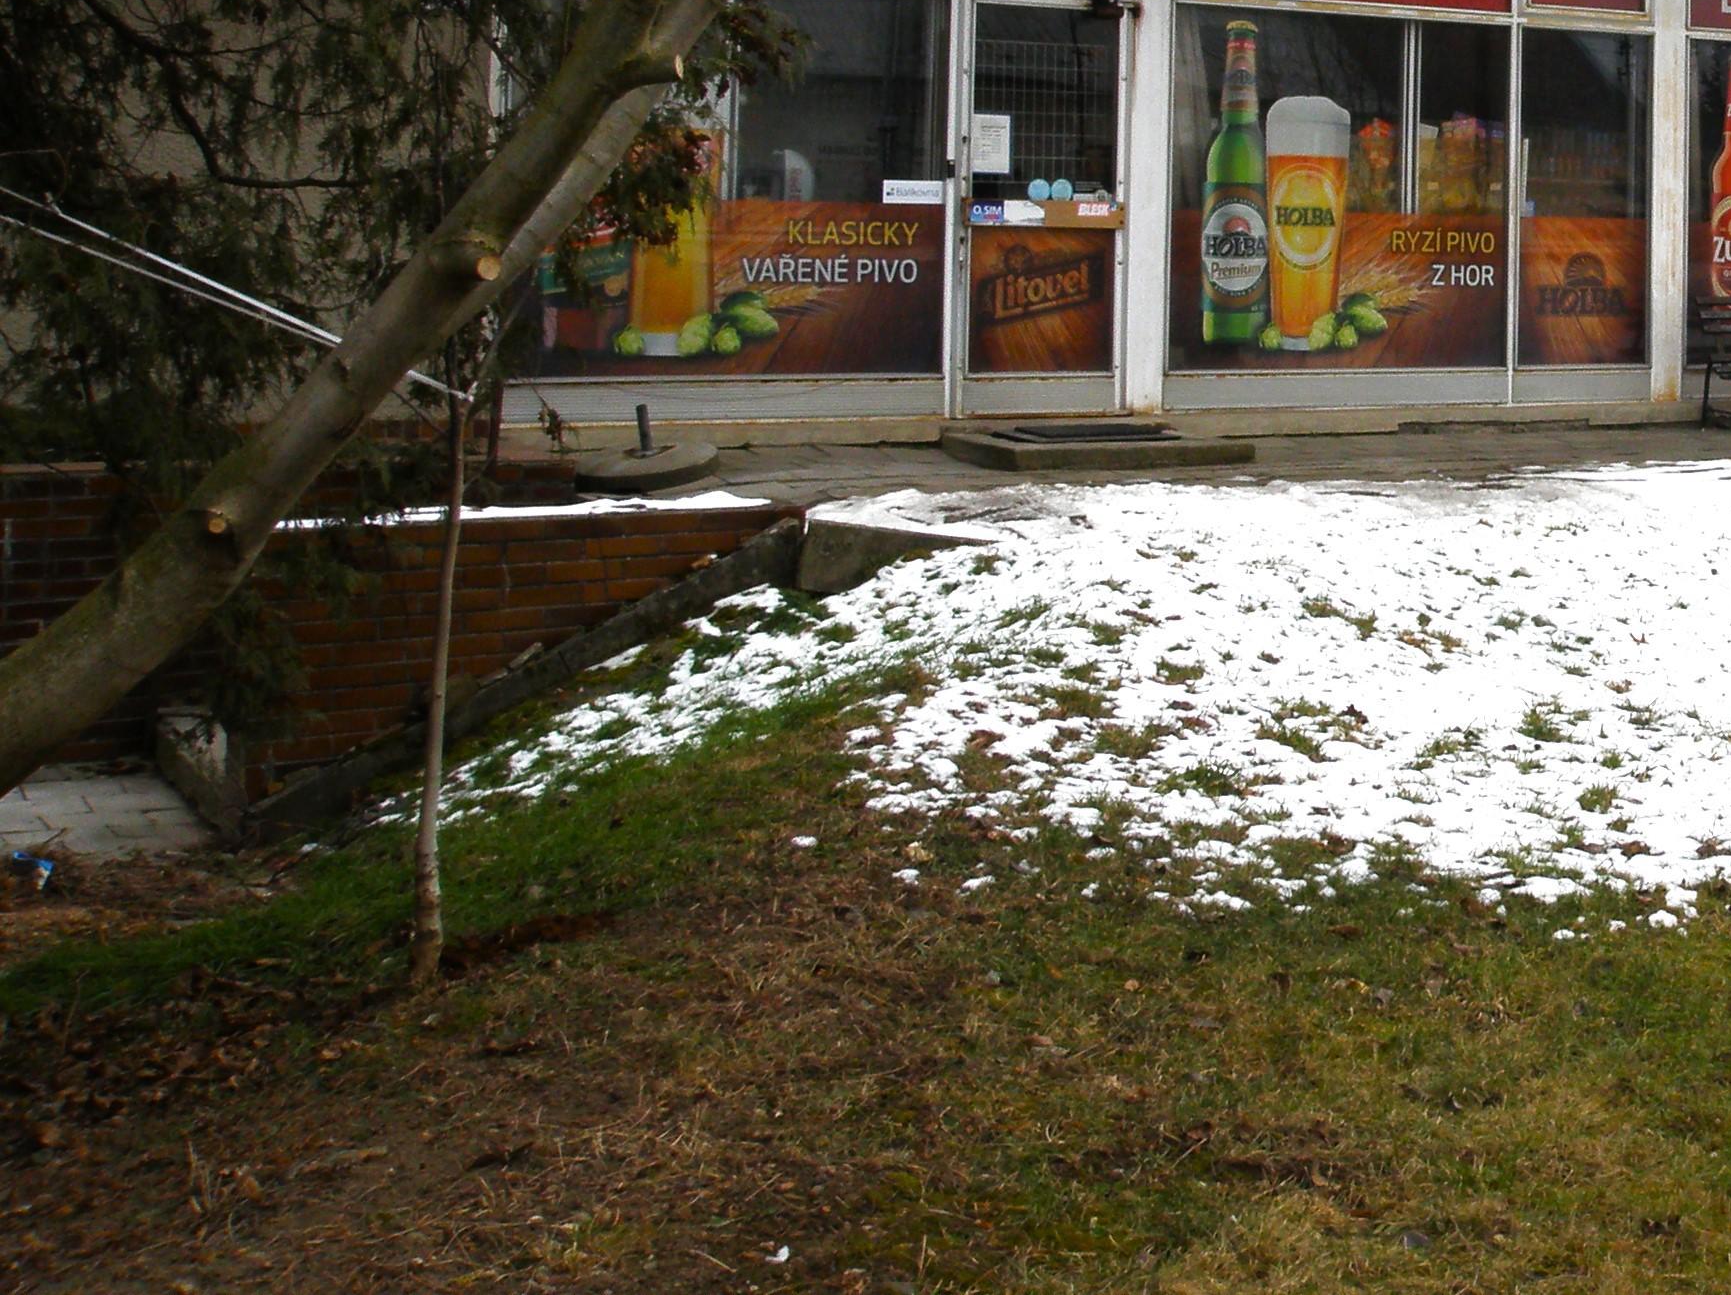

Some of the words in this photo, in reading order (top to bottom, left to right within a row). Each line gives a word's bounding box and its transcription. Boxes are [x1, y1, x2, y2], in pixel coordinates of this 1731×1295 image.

[1275, 206, 1336, 227] HOLBA
[788, 220, 919, 246] KLASICKY
[1391, 227, 1442, 253] RYZÍ
[1447, 231, 1496, 254] PIVO
[1204, 234, 1267, 257] HOLBA
[743, 253, 849, 283] VAŘENÉ
[857, 258, 918, 283] PIVO
[1211, 262, 1262, 280] Premium
[1432, 264, 1445, 286] Z
[1450, 264, 1495, 287] HOR
